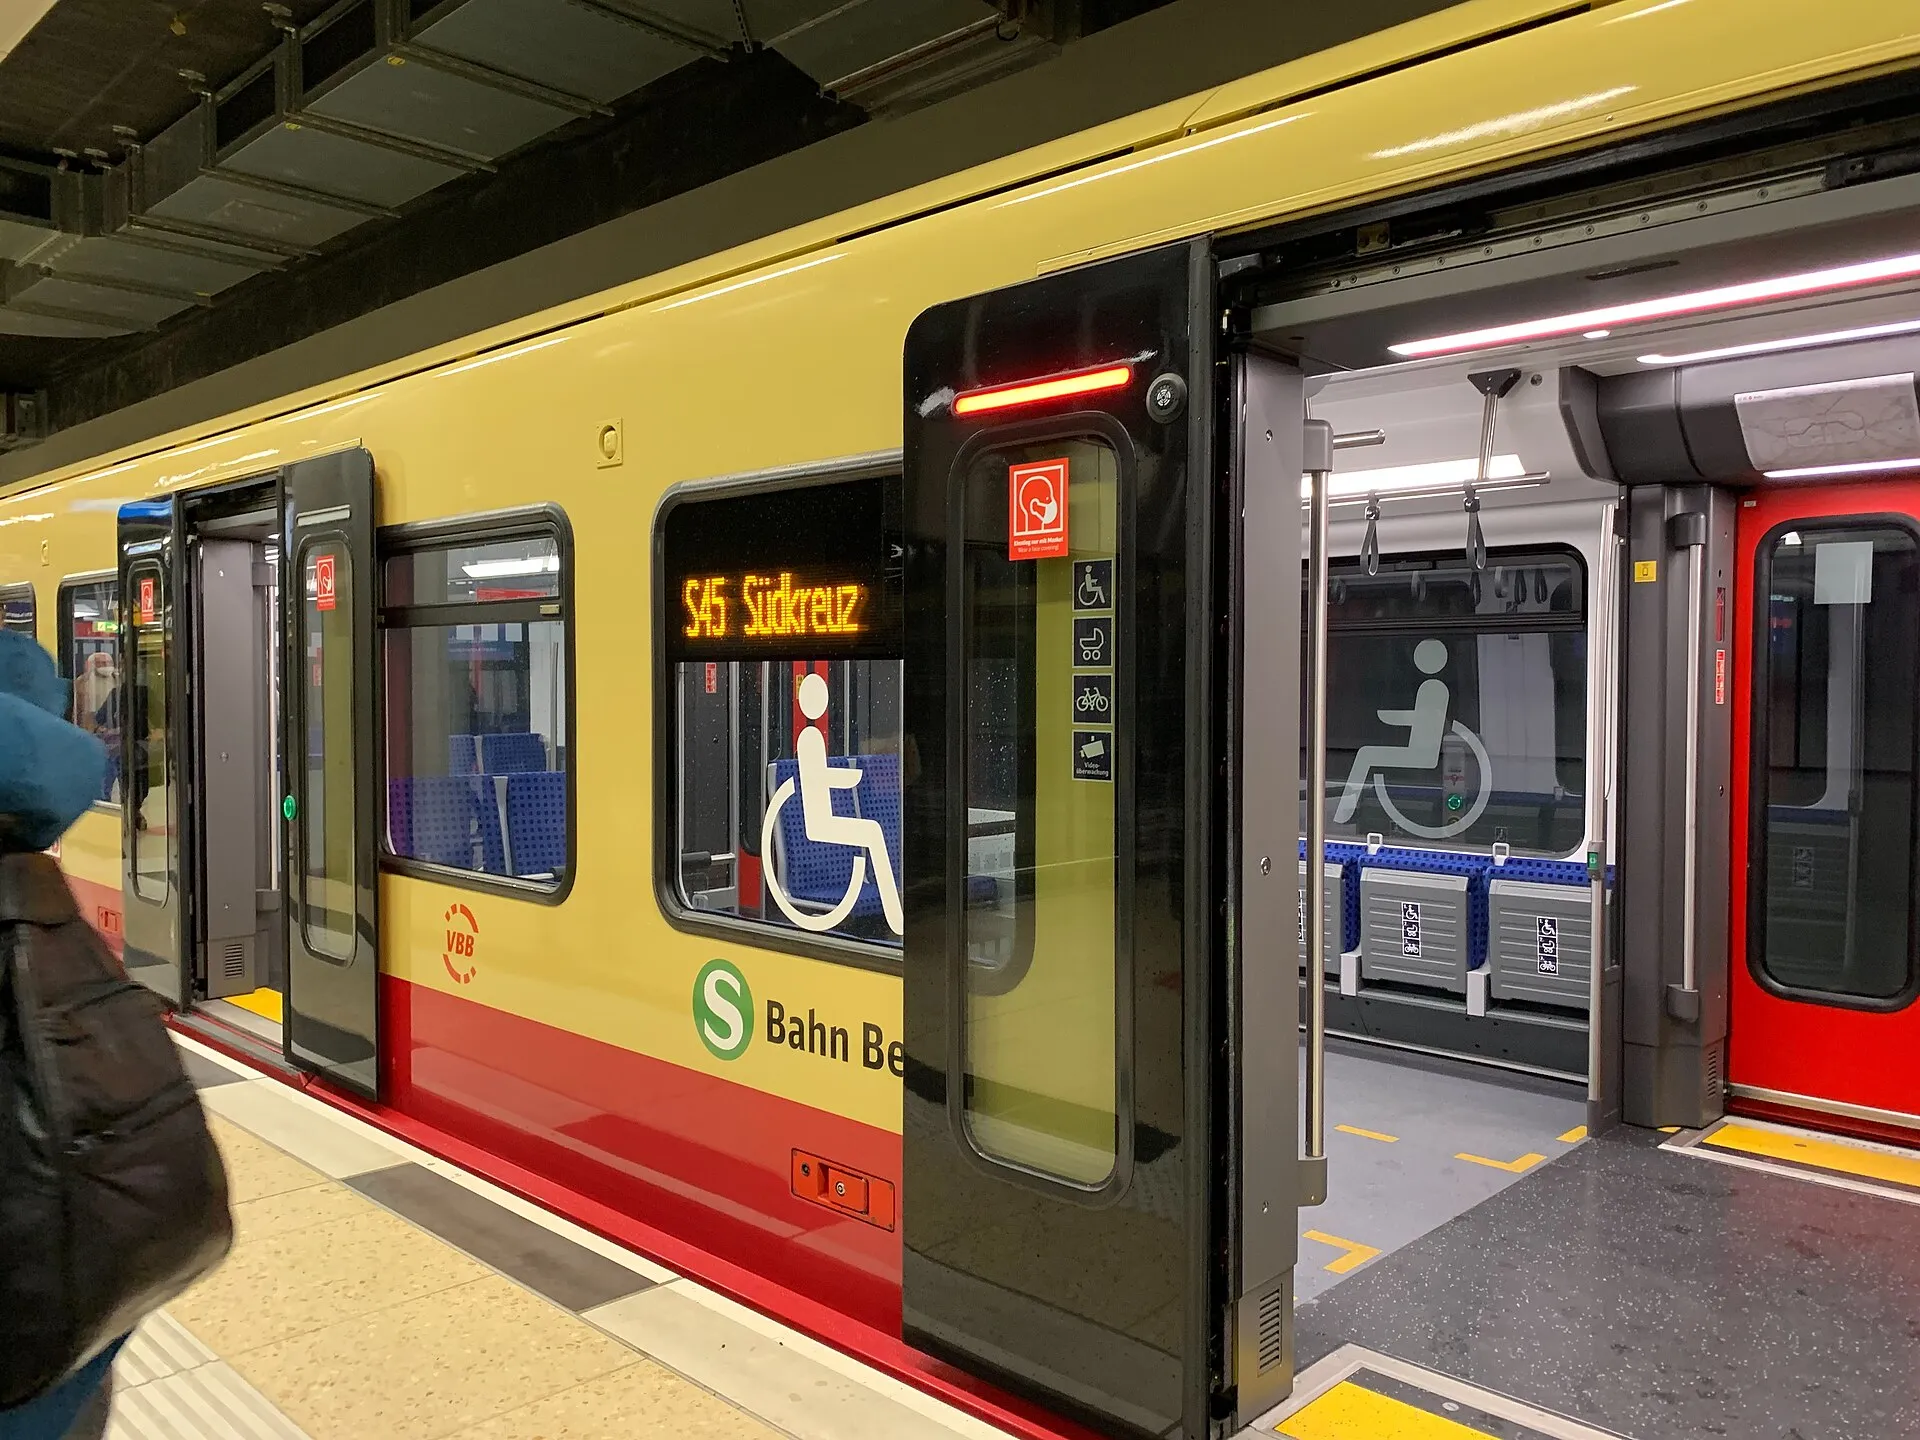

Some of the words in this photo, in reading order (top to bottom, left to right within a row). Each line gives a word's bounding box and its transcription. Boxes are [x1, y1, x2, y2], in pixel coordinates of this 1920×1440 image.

[685, 577, 725, 637] S45
[743, 572, 858, 635] Südkreuz
[1076, 767, 1109, 778] überwachung
[446, 929, 475, 957] VBB
[702, 968, 745, 1052] S
[766, 999, 849, 1063] Bahn
